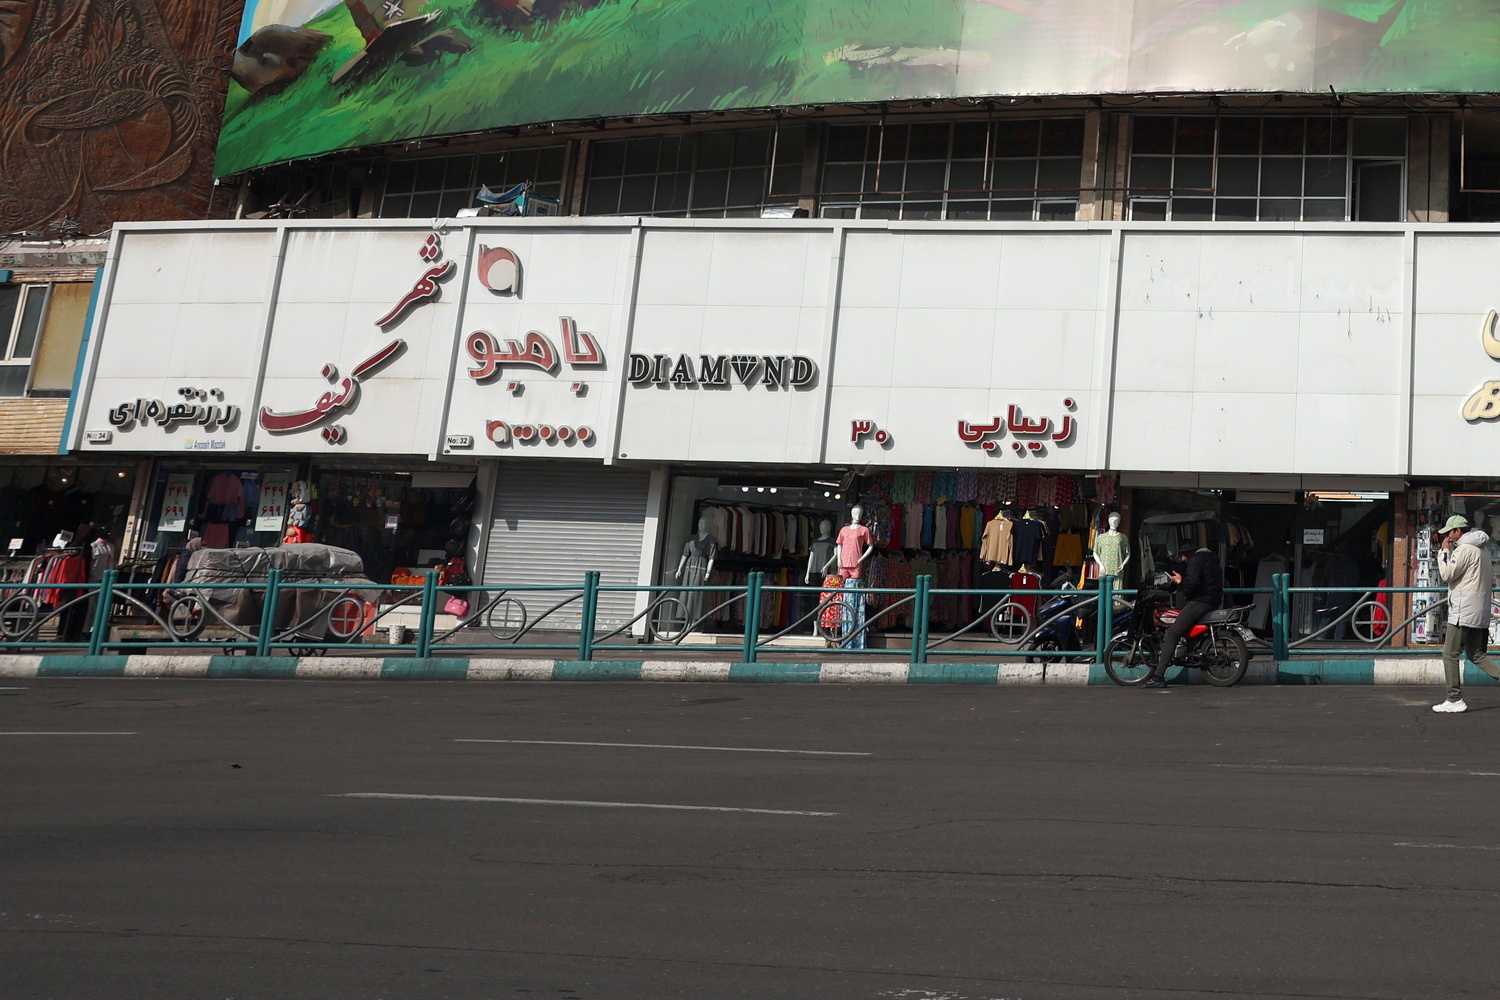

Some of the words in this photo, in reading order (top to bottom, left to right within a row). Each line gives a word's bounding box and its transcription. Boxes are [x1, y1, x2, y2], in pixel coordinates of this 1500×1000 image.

[375, 233, 454, 327] شهر
[466, 316, 601, 391] بامبو
[147, 386, 203, 427] نقره
[198, 387, 235, 426] رز
[260, 338, 404, 443] کیف
[109, 398, 145, 426] ای
[850, 418, 889, 445] ۳۰
[958, 398, 1075, 450] زیبایی
[261, 505, 281, 517] ۶۹۹
[264, 485, 284, 497] ۳۴۹
